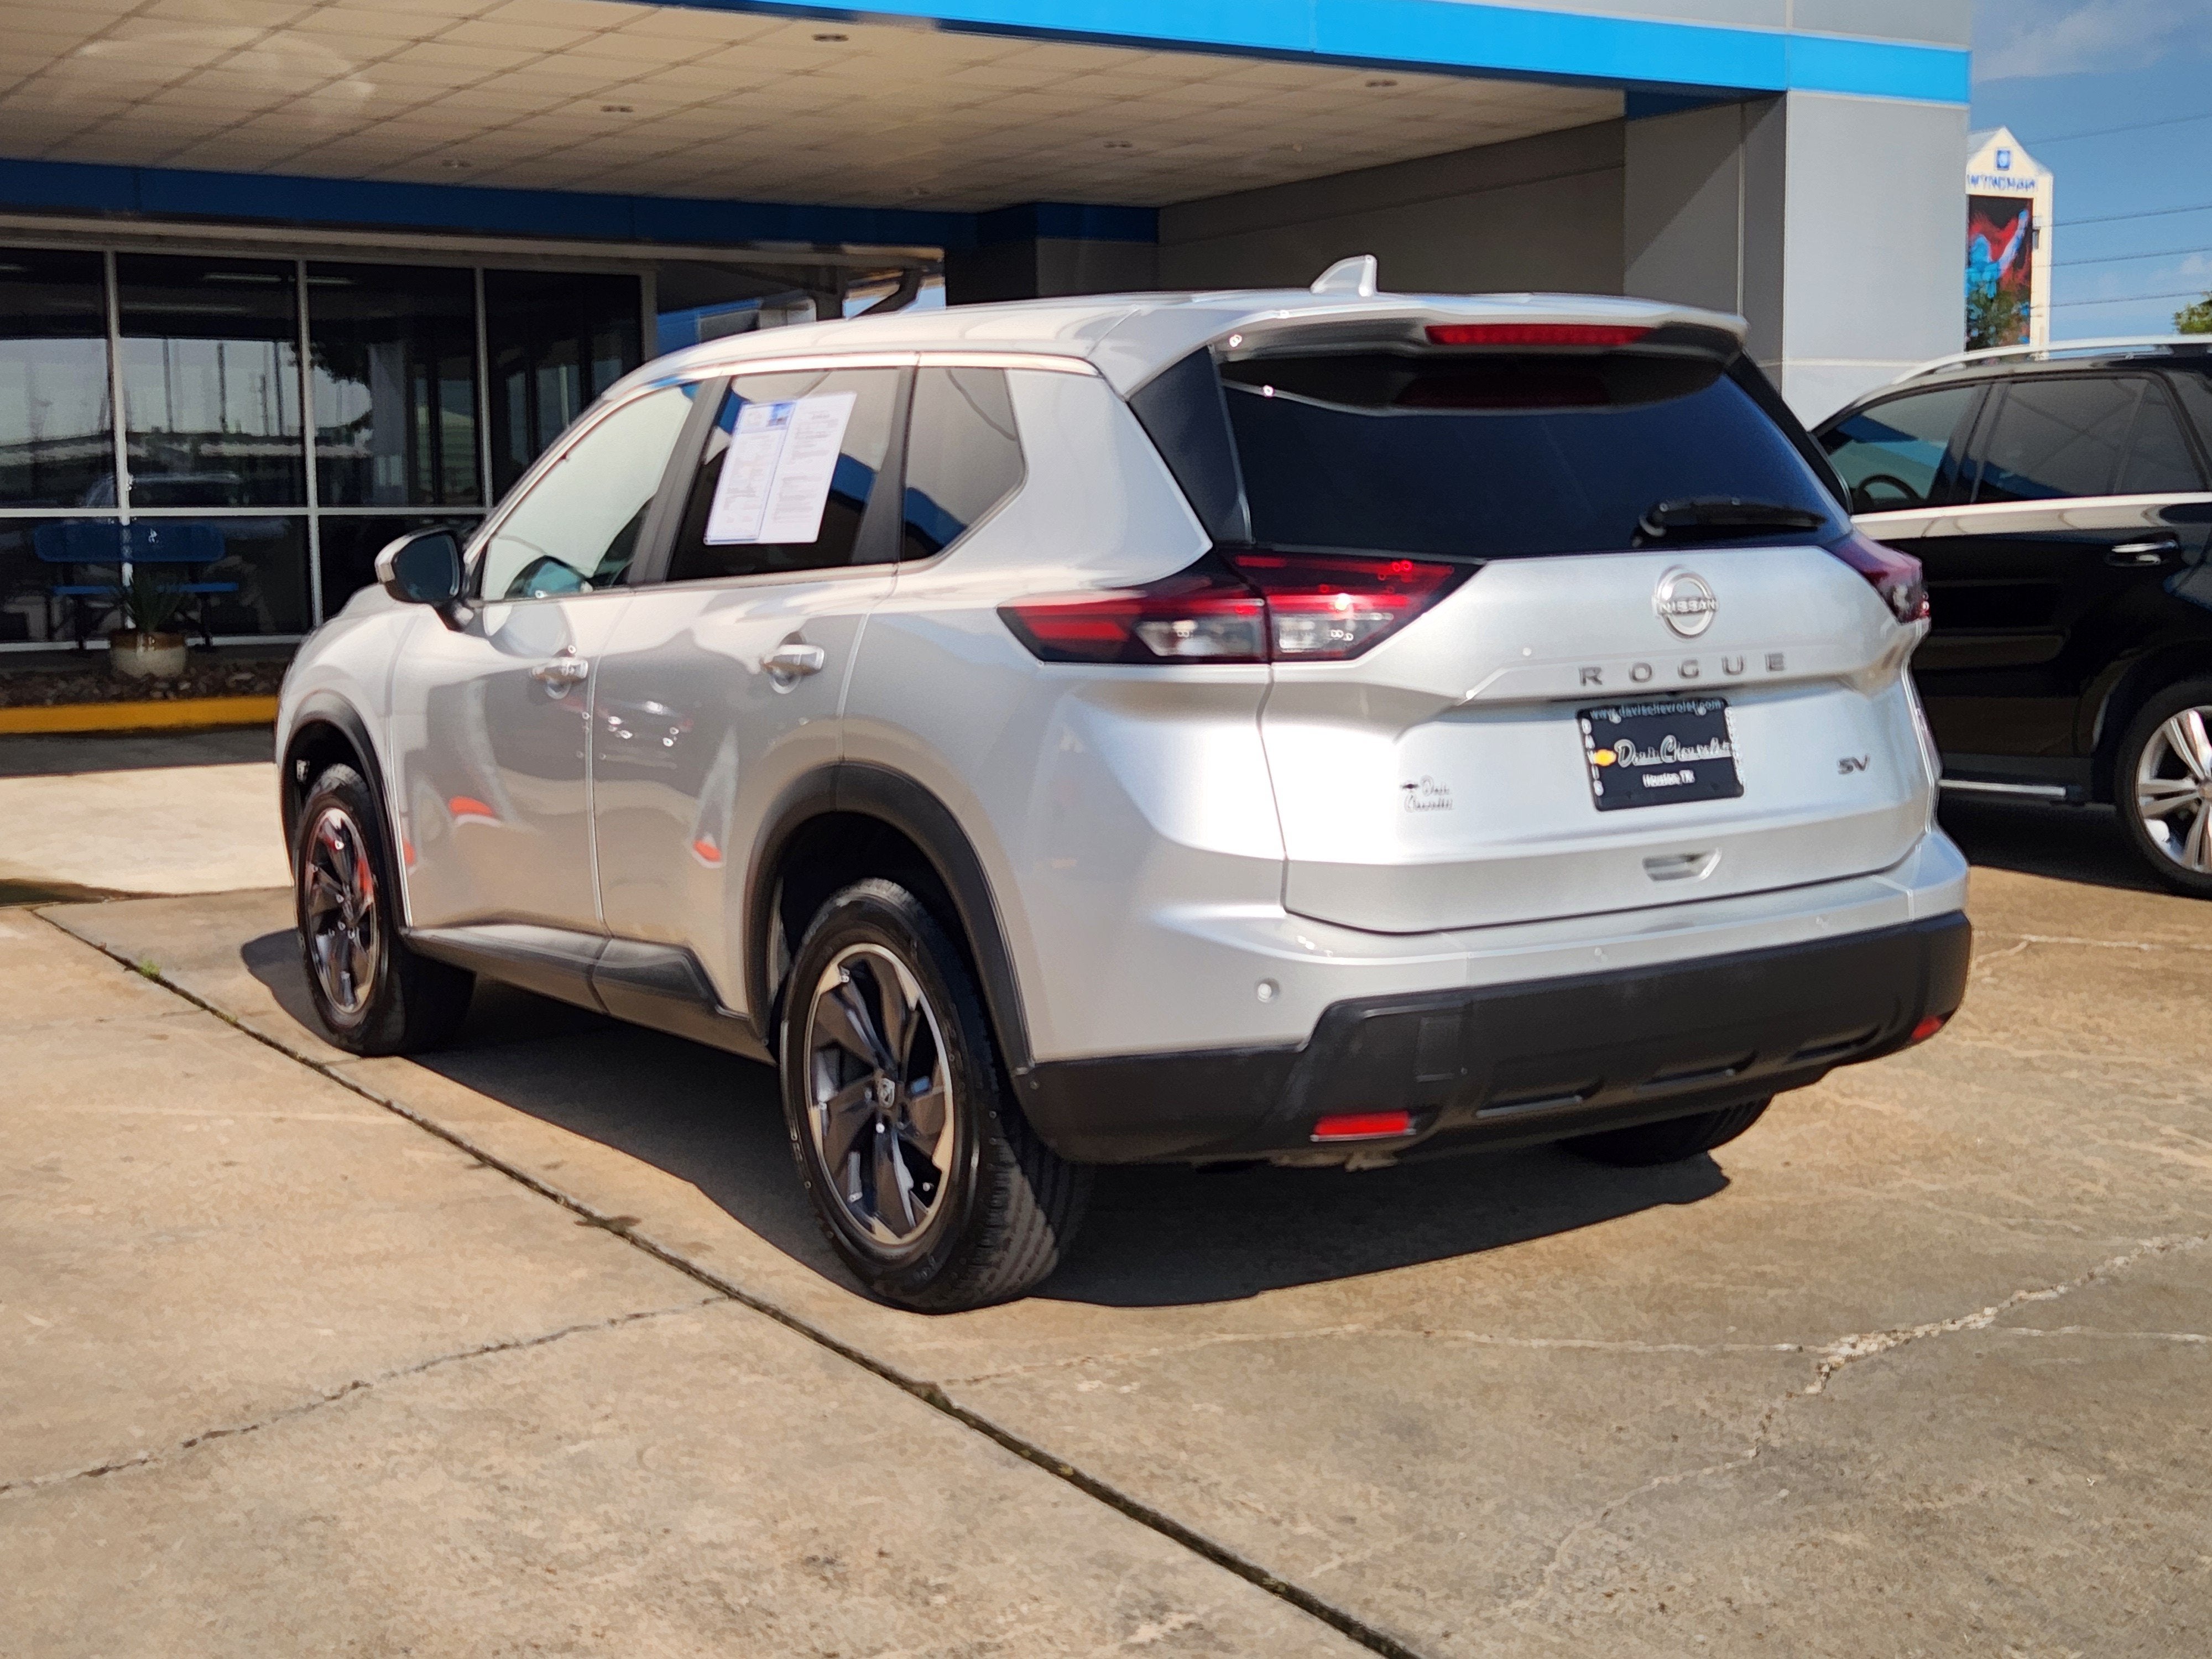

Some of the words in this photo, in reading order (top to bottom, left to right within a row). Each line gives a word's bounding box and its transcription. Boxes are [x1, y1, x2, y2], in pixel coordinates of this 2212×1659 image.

[1658, 598, 1717, 613] NISSAN
[1579, 652, 1786, 686] ROGUE
[1838, 754, 1870, 775] SV
